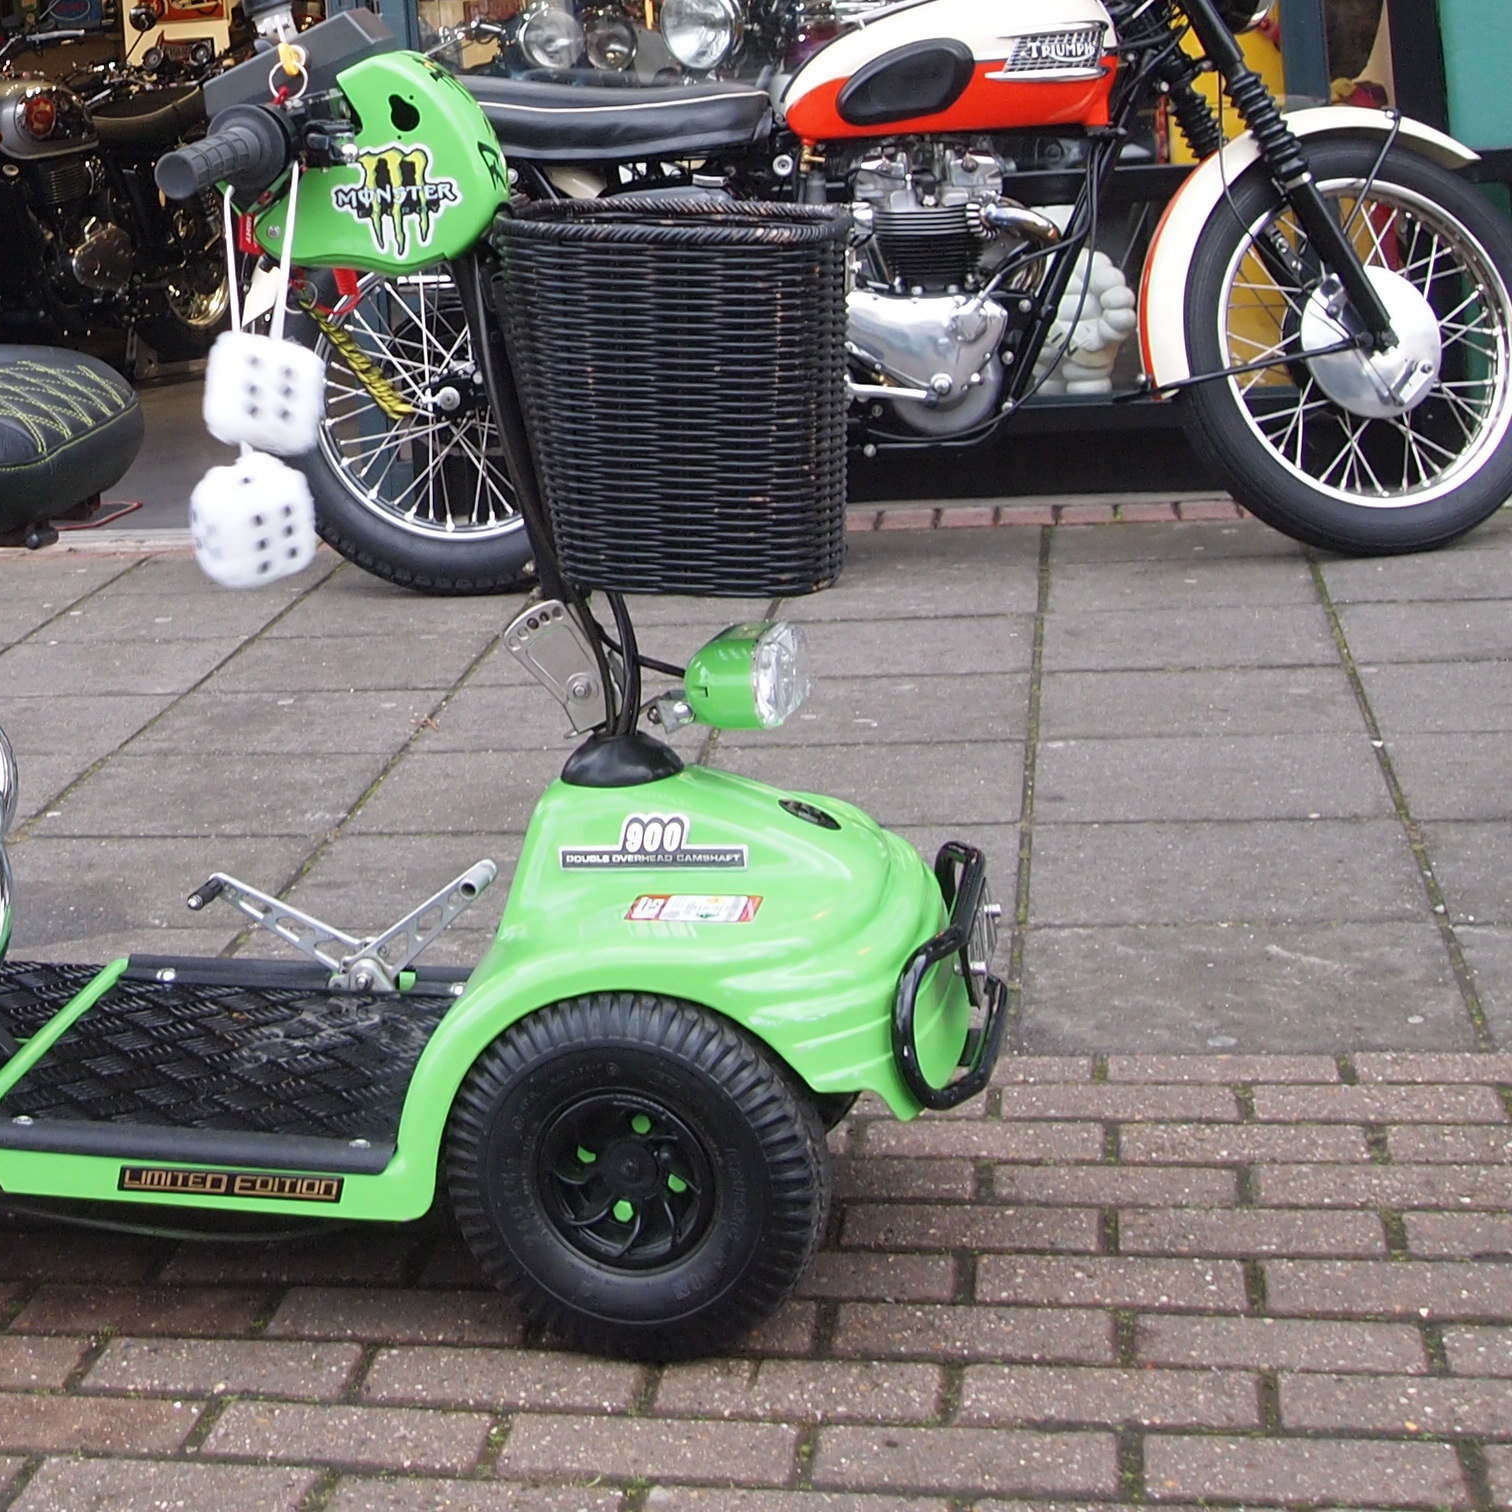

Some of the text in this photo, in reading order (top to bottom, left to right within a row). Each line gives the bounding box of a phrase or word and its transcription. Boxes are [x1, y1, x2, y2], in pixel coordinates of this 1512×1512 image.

[1028, 40, 1095, 62] TRIUMPH
[337, 183, 457, 208] MONSTER
[624, 820, 683, 852] 900
[566, 853, 741, 864] DOUBLE OVERHEAD CAMSHAFT
[123, 1169, 338, 1201] LIMITED EDITION
